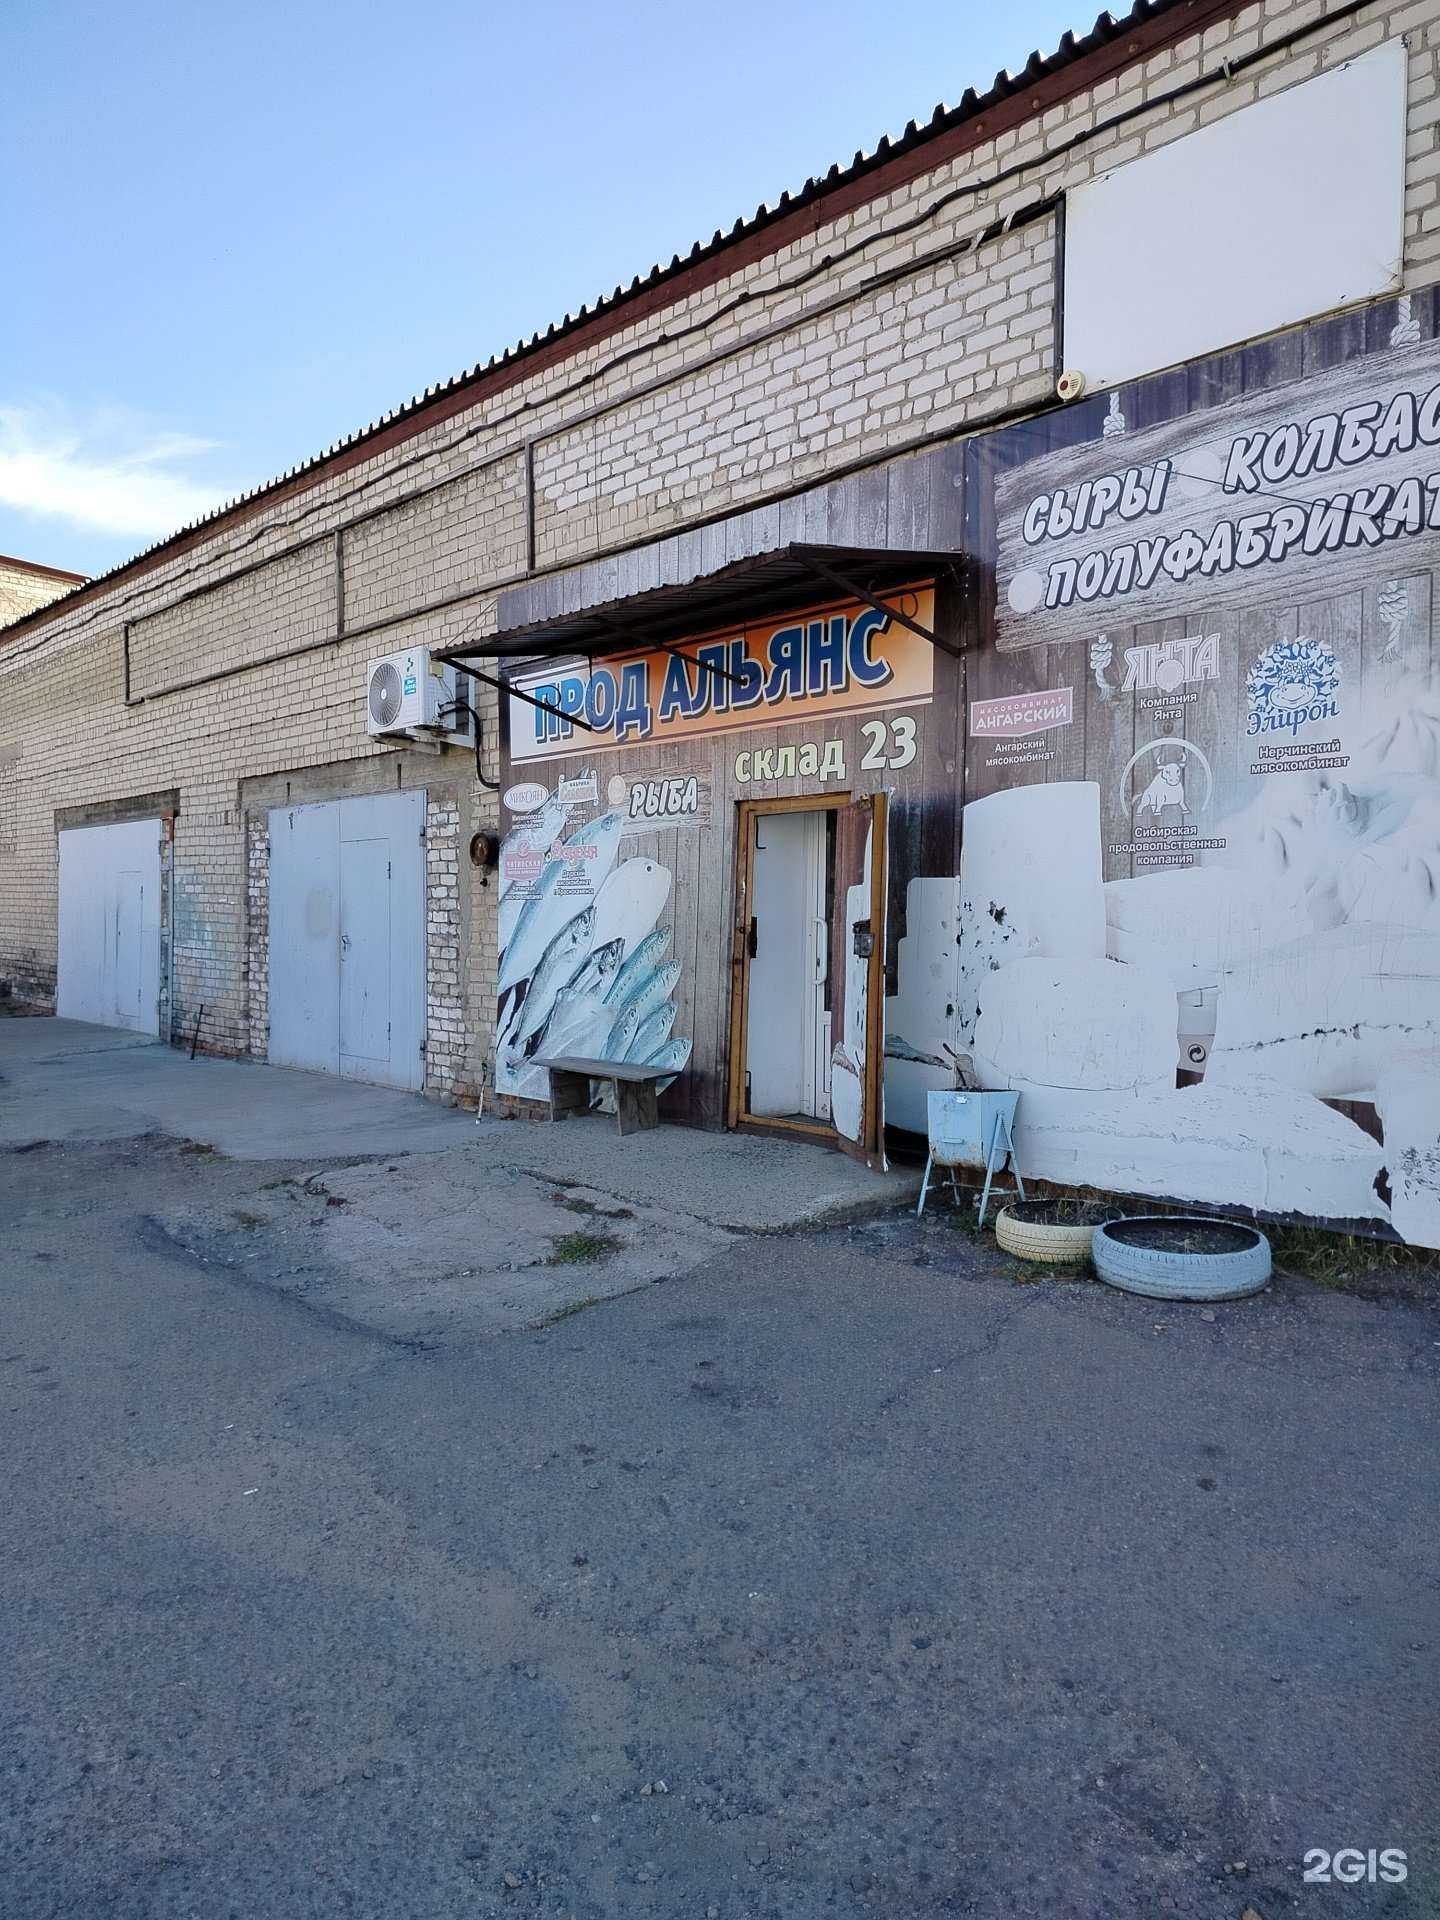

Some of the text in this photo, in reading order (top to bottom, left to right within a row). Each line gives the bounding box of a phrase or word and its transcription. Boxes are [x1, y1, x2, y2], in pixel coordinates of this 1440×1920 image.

[1022, 459, 1173, 545] СЫРЫ
[533, 606, 894, 743] ПРОД АЛЬЯНС
[1140, 693, 1197, 709] Компания
[976, 703, 1067, 730] АНГАРСКИЙ
[1153, 708, 1183, 721] Янта
[1246, 700, 1340, 736] Элирон
[734, 716, 918, 783] склад 23
[995, 738, 1045, 753] Ангарский
[1258, 739, 1341, 759] Нерчинский
[985, 751, 1055, 767] мясокомбинат
[1250, 755, 1351, 775] мясокомбинат
[629, 776, 698, 819] РЫБА
[1134, 824, 1197, 838] Сибирская
[1108, 837, 1226, 854] продовольственная
[1136, 853, 1194, 866] компания
